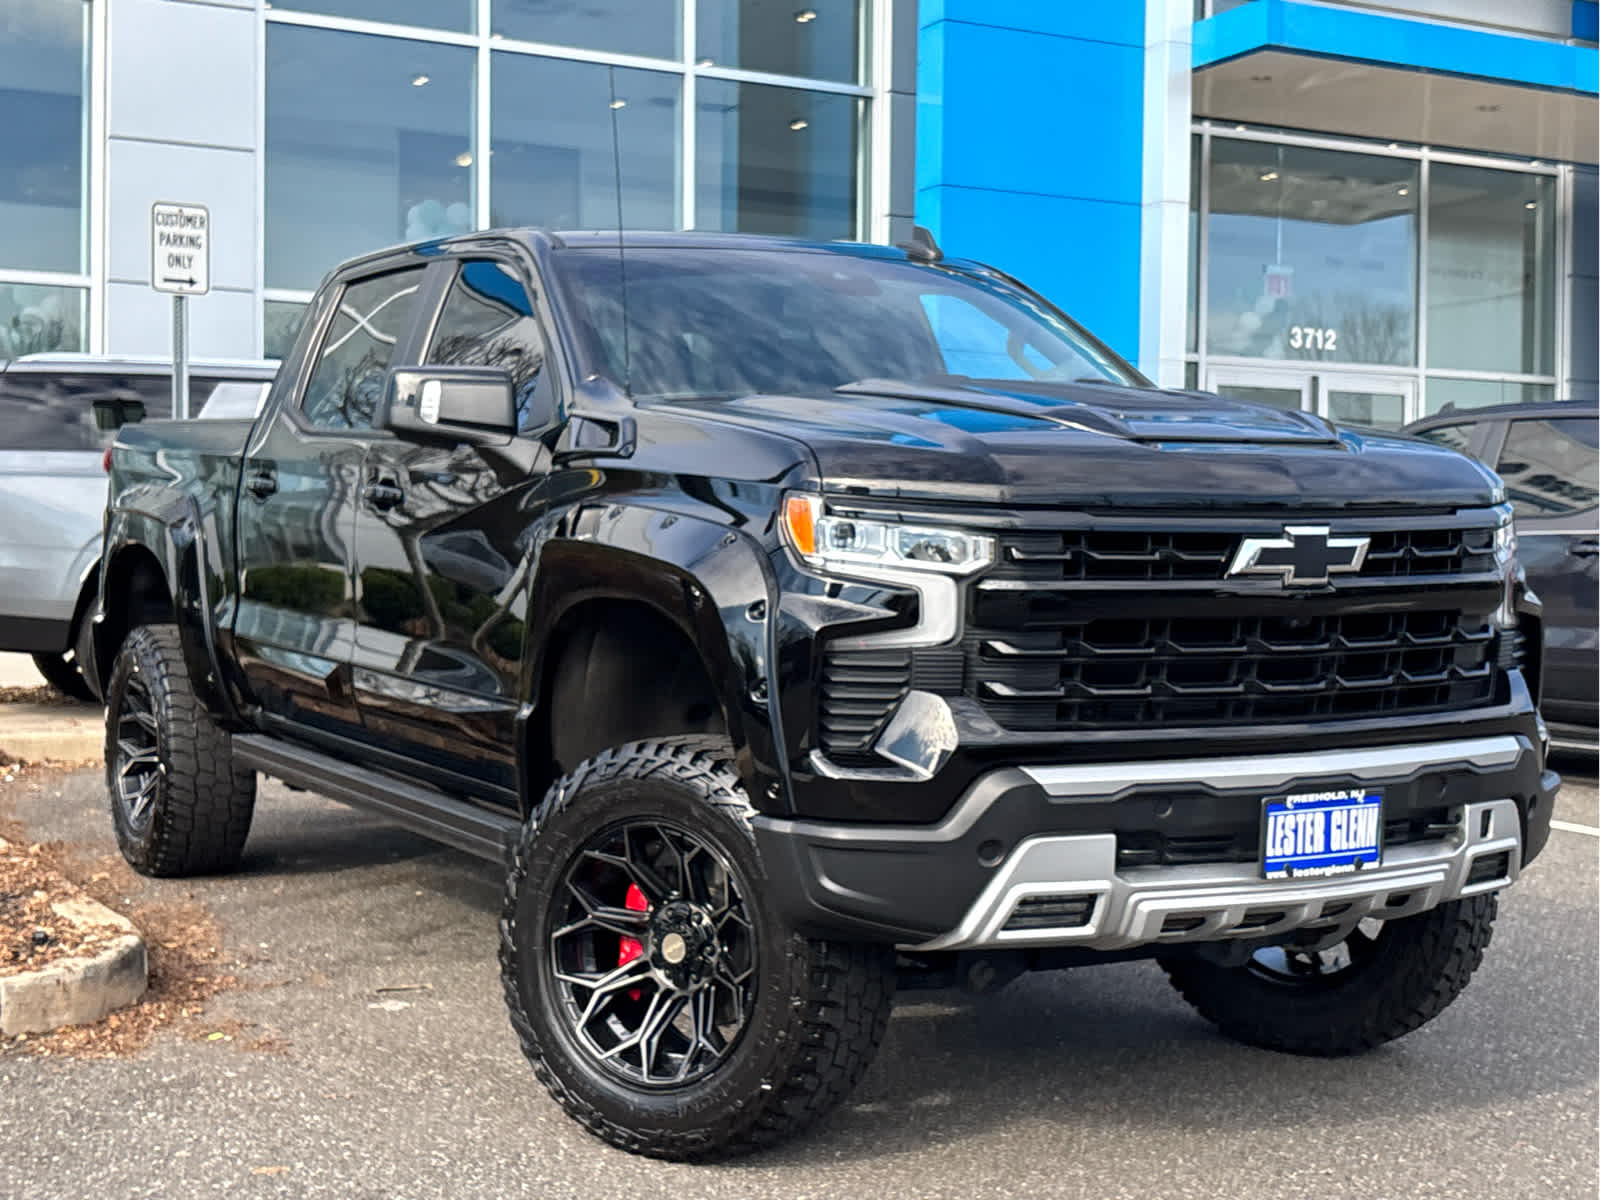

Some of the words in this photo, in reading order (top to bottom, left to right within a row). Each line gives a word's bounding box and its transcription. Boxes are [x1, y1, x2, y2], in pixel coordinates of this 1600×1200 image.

[156, 211, 205, 229] CUSTOMER
[159, 231, 202, 250] PARKING
[167, 252, 194, 269] ONLY
[1289, 326, 1337, 351] 3712
[1265, 811, 1326, 858] LESTER
[1330, 807, 1379, 852] GLENN
